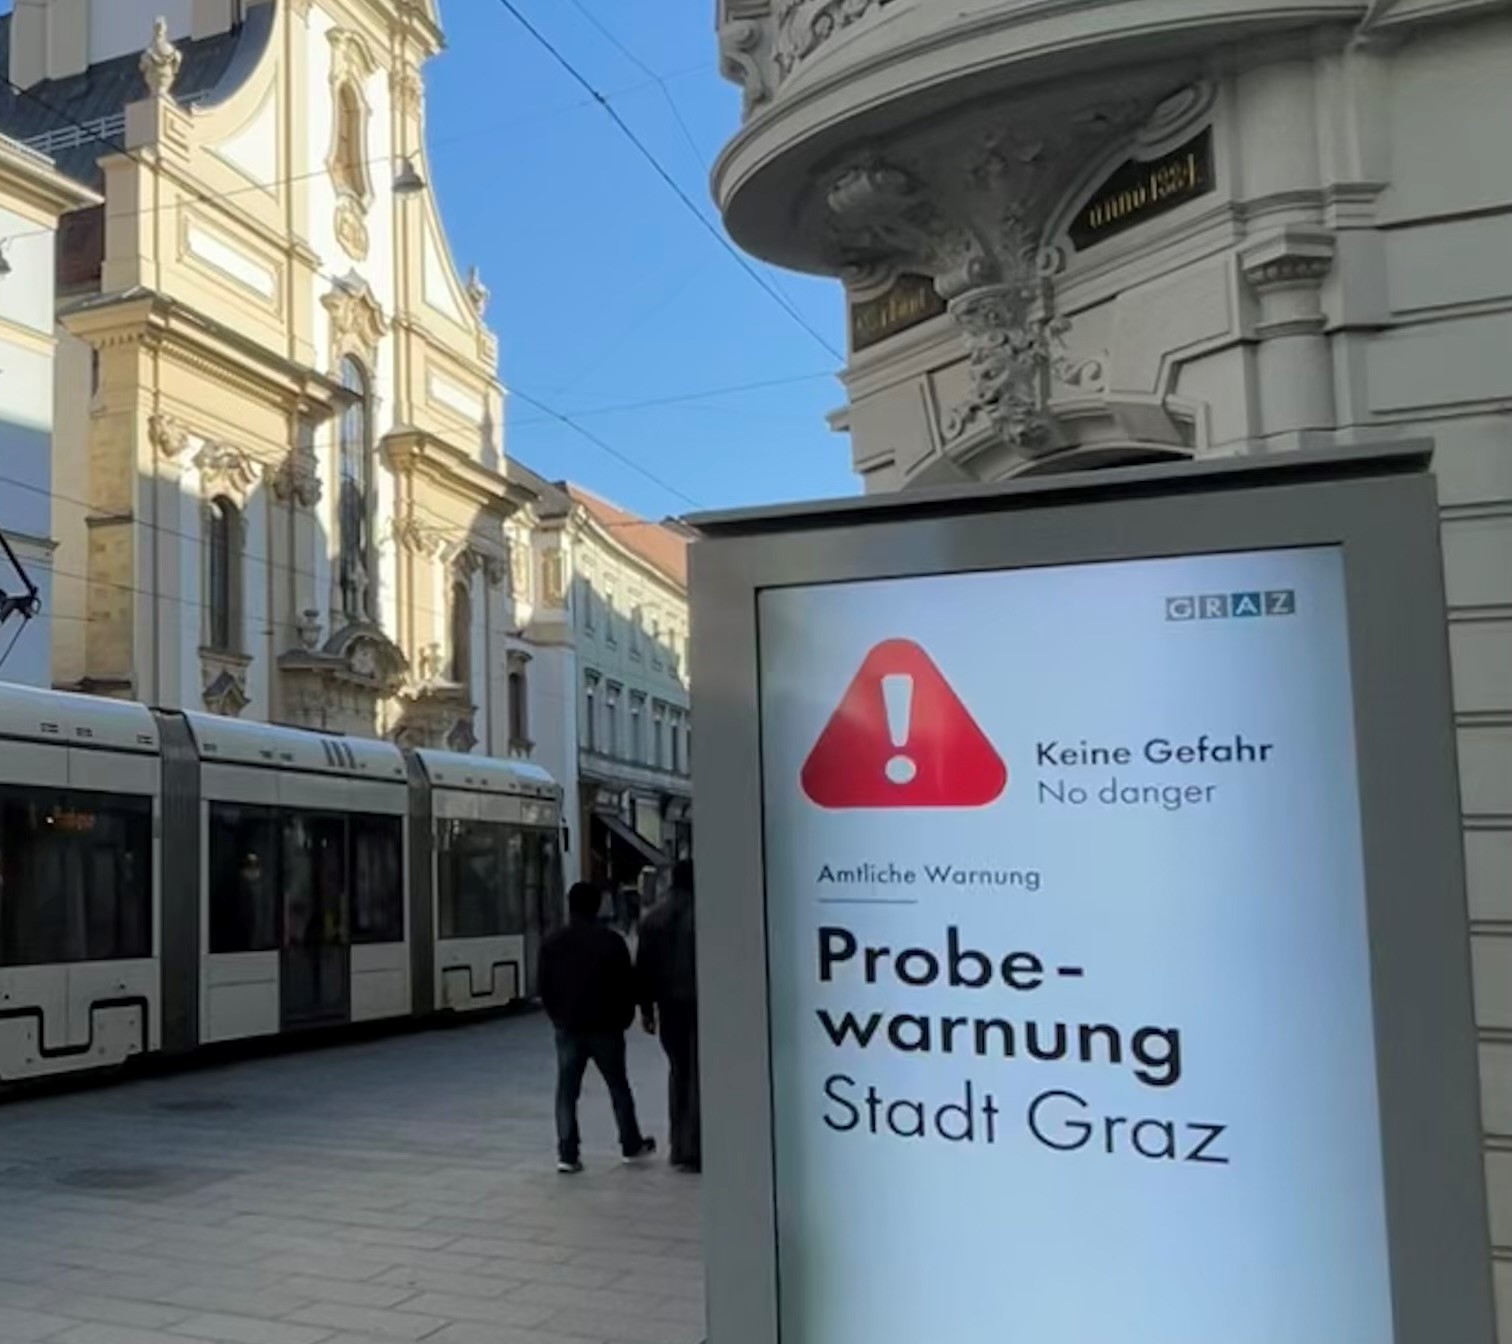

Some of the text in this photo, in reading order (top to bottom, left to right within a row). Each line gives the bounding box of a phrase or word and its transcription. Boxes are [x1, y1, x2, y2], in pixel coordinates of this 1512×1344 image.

[1165, 589, 1295, 621] GRAZ
[1036, 737, 1274, 767] Keine Gefahr
[1037, 780, 1218, 811] No danger
[816, 862, 1042, 891] Amtliche Warnung
[817, 926, 1084, 991] Probe-
[816, 1009, 1183, 1086] warnung
[822, 1073, 1230, 1164] Stadt Graz
